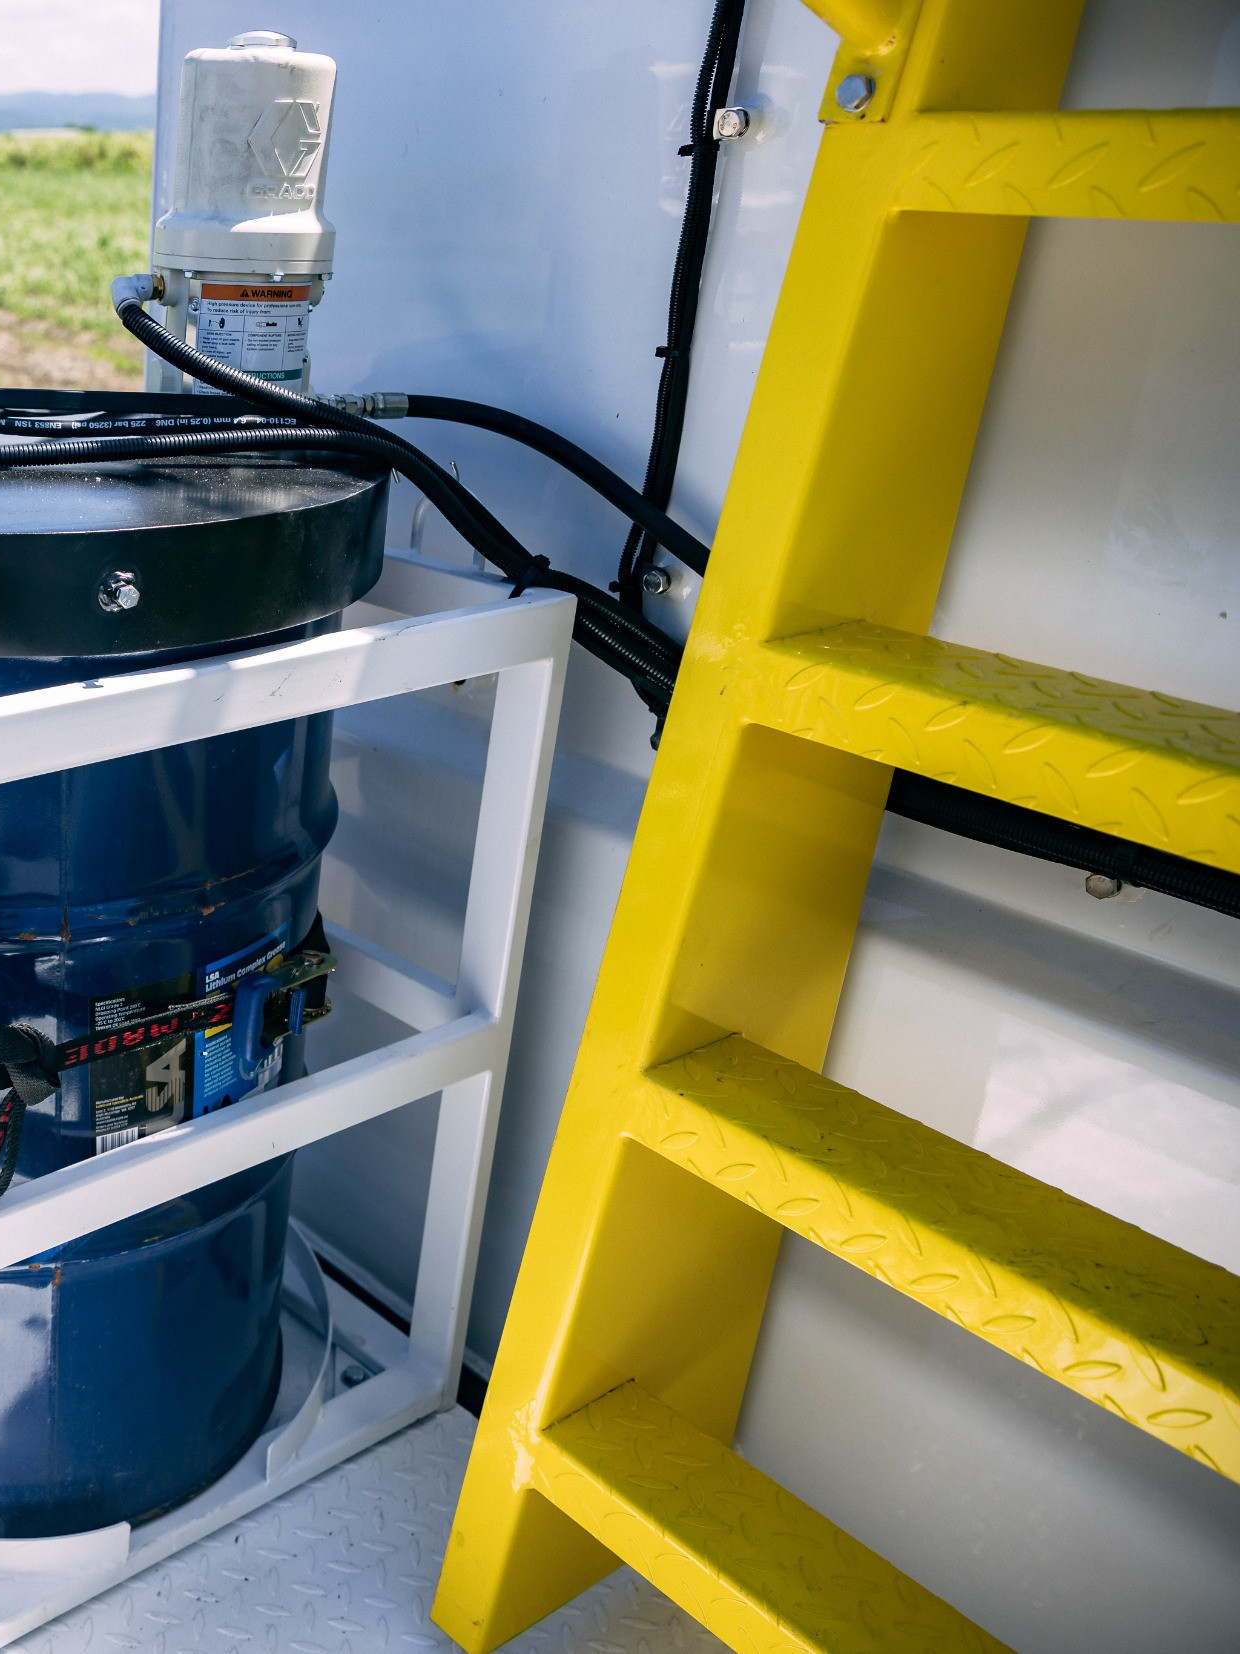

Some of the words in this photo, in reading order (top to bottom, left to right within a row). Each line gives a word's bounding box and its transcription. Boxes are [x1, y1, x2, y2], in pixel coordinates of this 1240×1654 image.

[247, 182, 315, 199] GRACO
[251, 289, 293, 299] WARNING
[14, 420, 32, 428] 1SN
[34, 421, 62, 429] EN853
[71, 421, 87, 429] psi)
[190, 417, 211, 425] (0.25
[205, 973, 236, 993] Lithium
[236, 955, 266, 978] Complex
[266, 941, 286, 960] Grease
[205, 971, 220, 983] LSA
